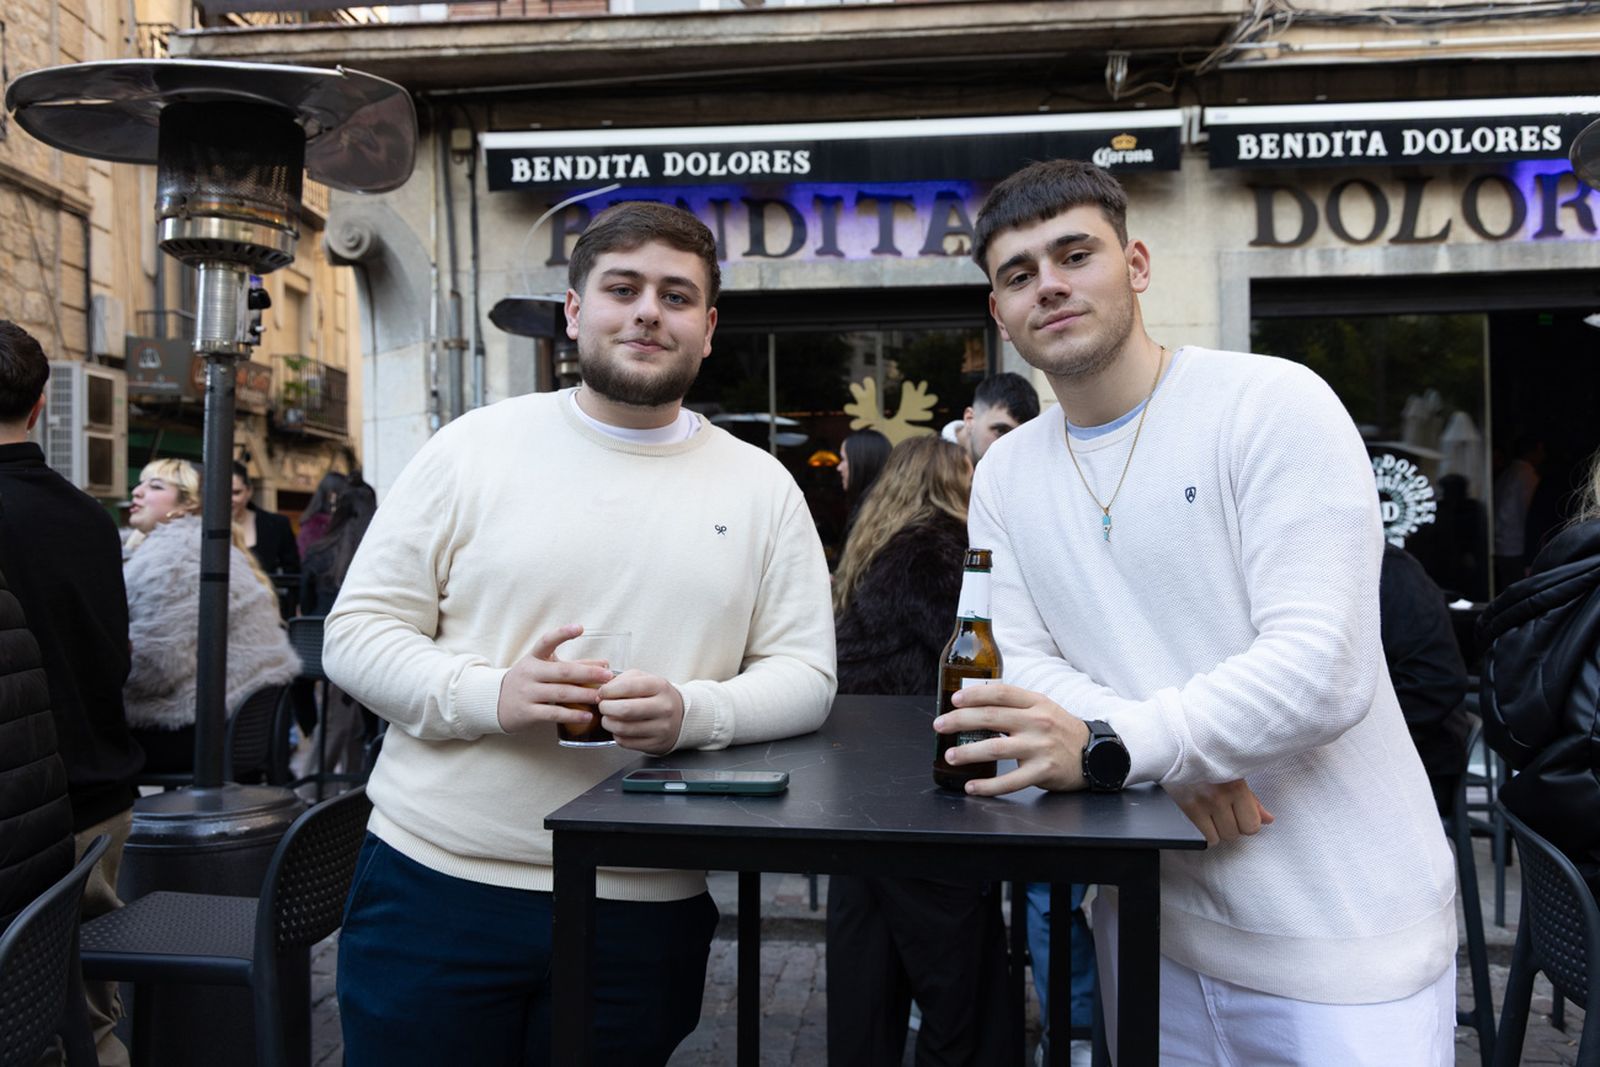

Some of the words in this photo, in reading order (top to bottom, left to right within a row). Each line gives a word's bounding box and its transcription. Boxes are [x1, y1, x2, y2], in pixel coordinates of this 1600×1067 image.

[1092, 146, 1154, 169] Corona
[1236, 130, 1388, 160] BENDITA
[1401, 124, 1563, 156] DOLORES
[510, 154, 651, 183] BENDITA
[662, 150, 812, 177] DOLORES
